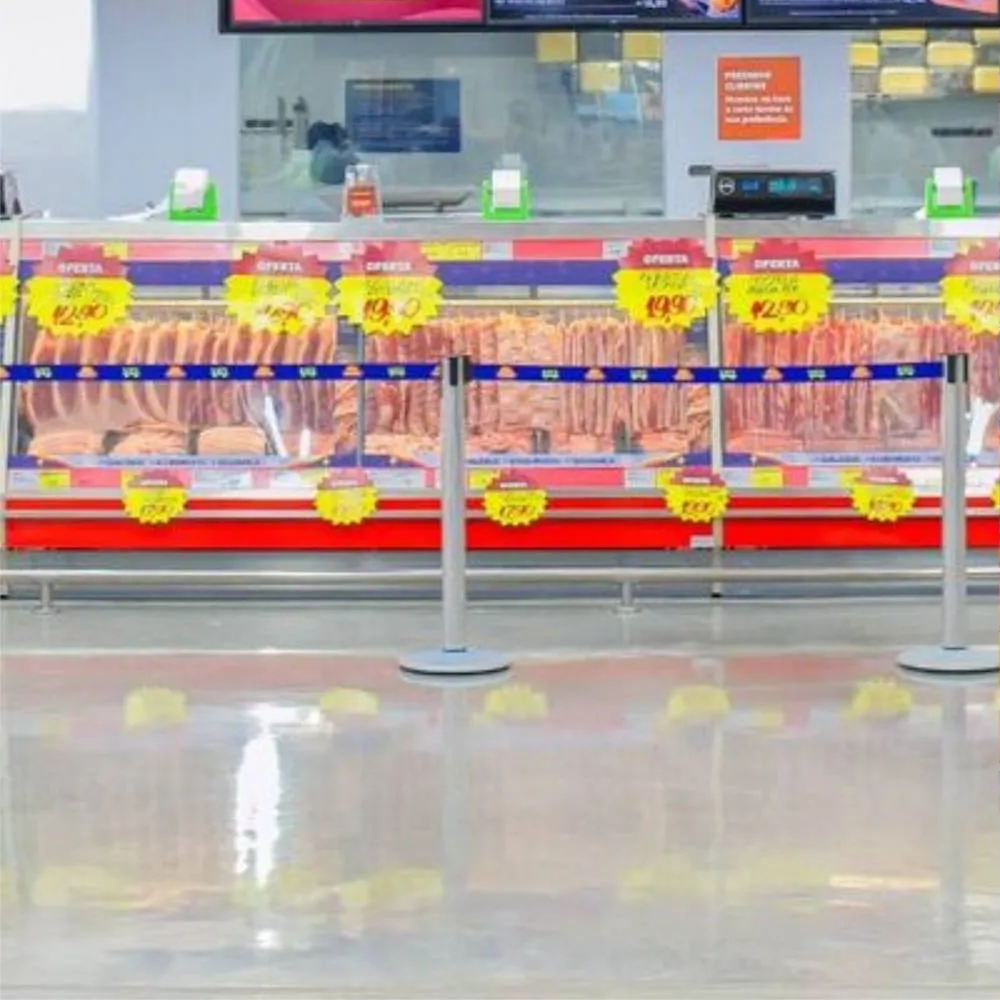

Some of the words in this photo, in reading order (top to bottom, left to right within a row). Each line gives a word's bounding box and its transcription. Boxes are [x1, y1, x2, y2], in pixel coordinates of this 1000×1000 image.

[642, 253, 689, 265] OFERTA
[754, 258, 800, 269] OFERTA
[57, 262, 103, 273] OFERTA
[256, 261, 302, 272] OFERTA
[366, 261, 412, 272] OFERTA
